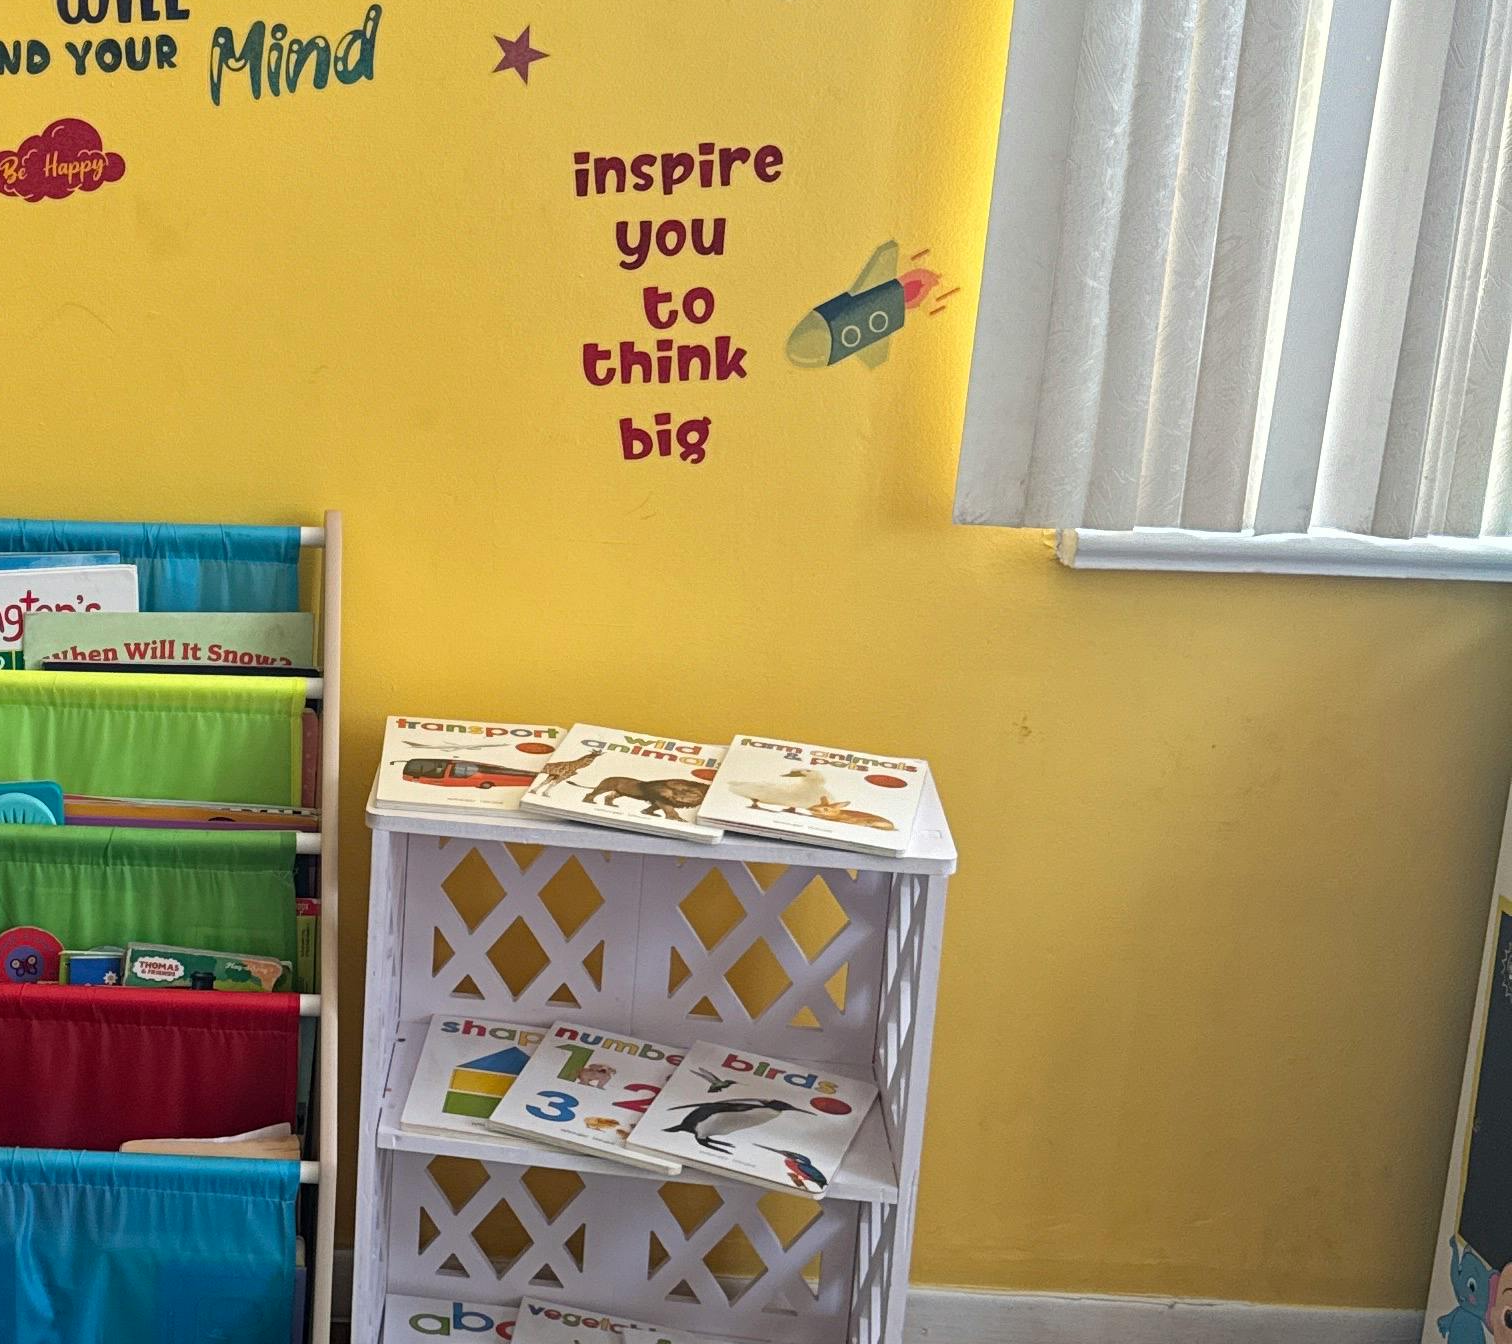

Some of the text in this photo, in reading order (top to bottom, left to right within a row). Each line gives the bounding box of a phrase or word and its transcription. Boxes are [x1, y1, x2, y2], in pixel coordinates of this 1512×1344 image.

[65, 34, 177, 76] YOUR
[209, 3, 382, 106] Mind
[0, 148, 105, 184] Be Happy
[574, 142, 783, 196] inspire
[615, 218, 726, 270] you
[643, 286, 716, 329] to
[583, 336, 747, 386] think
[619, 412, 712, 464] big
[124, 639, 175, 661] Will
[182, 642, 202, 660] It
[395, 718, 559, 739] transport
[624, 735, 702, 755] wild
[581, 739, 722, 768] animal
[740, 737, 919, 773] farm animals
[783, 751, 870, 772] & pets
[139, 960, 180, 972] THOMAS
[721, 1053, 839, 1094] birds
[525, 1090, 580, 1123] 3
